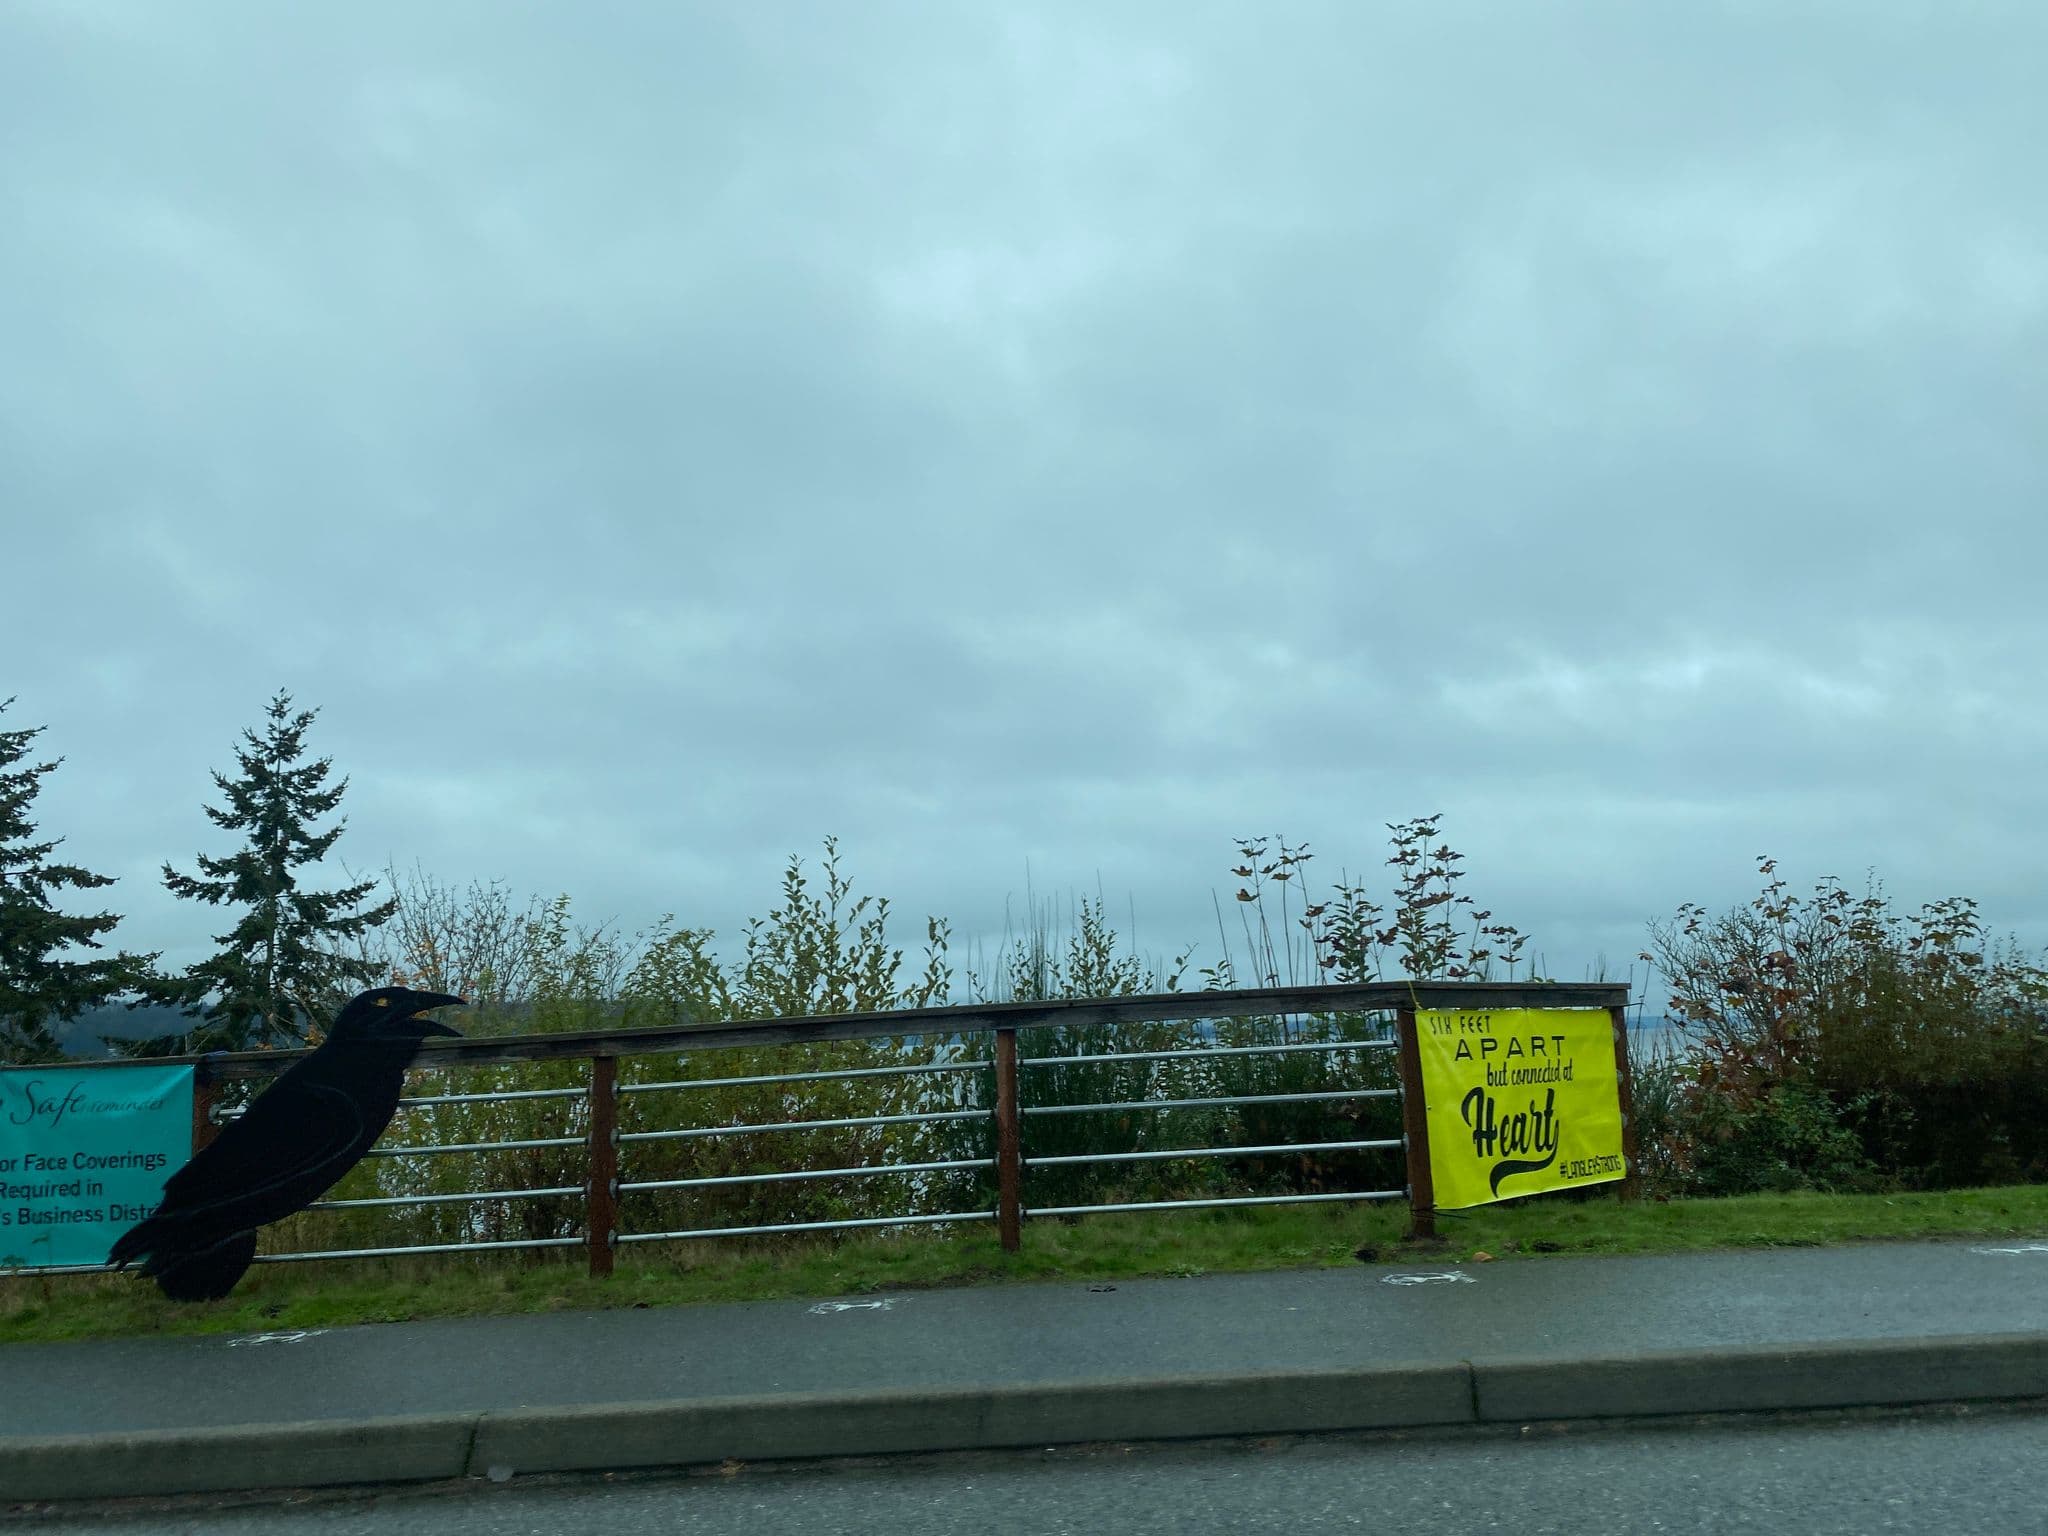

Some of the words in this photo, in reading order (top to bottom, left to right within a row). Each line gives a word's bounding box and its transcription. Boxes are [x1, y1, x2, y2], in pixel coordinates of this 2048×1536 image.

[1430, 1016, 1452, 1035] SIX
[1460, 1016, 1491, 1034] FEET
[1454, 1036, 1565, 1061] APART
[1487, 1061, 1508, 1086] but
[1511, 1058, 1560, 1086] connected
[1563, 1058, 1573, 1081] at
[10, 1081, 86, 1128] Safe
[1461, 1087, 1559, 1160] Heart
[24, 1154, 67, 1171] Face
[73, 1151, 166, 1171] Coverings
[0, 1179, 80, 1201] Required
[87, 1180, 102, 1197] in
[18, 1207, 103, 1226] Business
